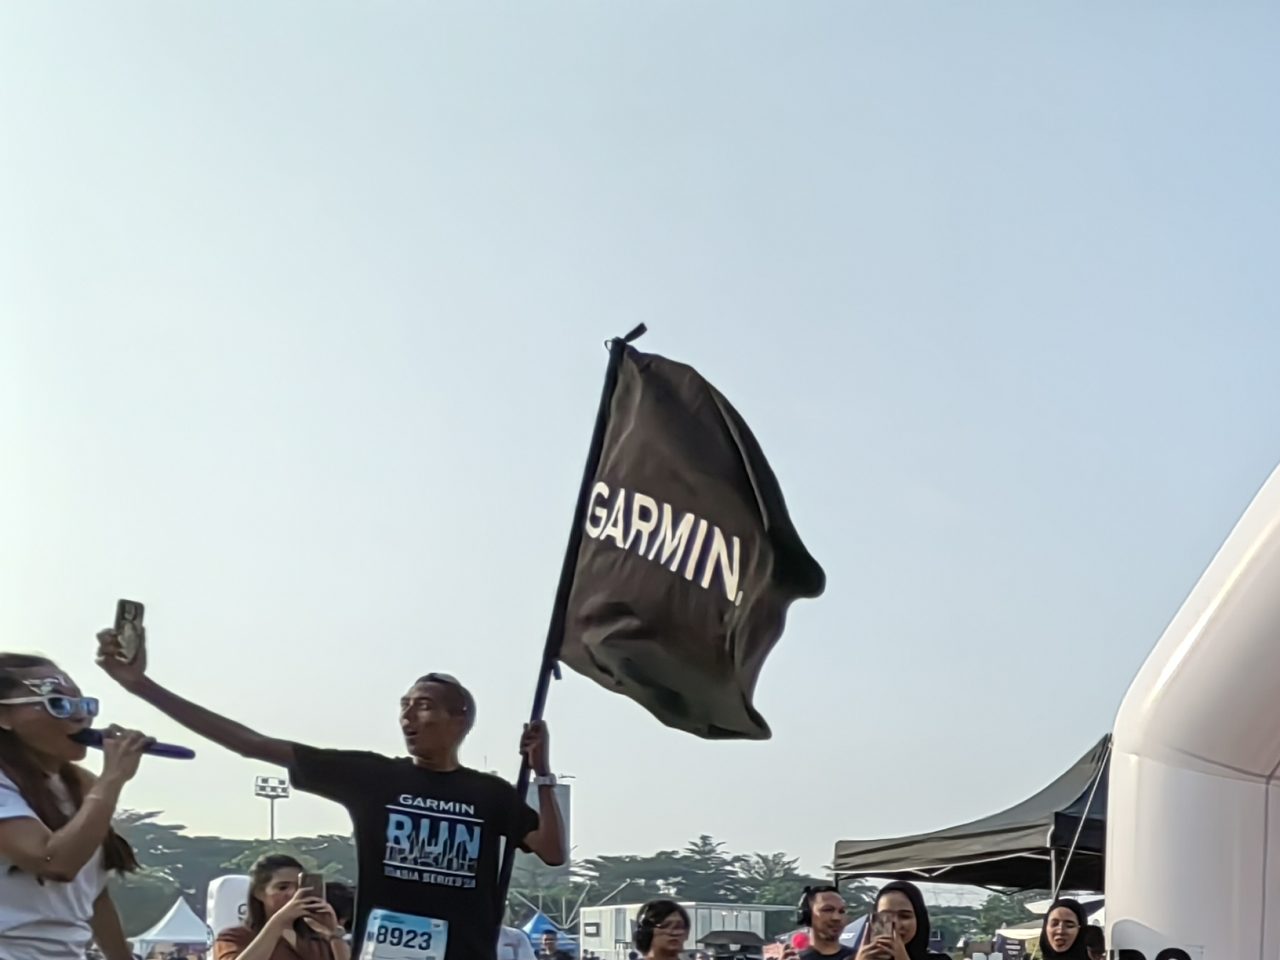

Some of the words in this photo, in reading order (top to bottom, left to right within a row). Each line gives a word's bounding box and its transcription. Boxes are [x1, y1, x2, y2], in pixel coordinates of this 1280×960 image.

[586, 481, 741, 602] GARMIN
[399, 794, 475, 815] GARMIN
[386, 813, 482, 860] RUN
[376, 925, 433, 951] 8923
